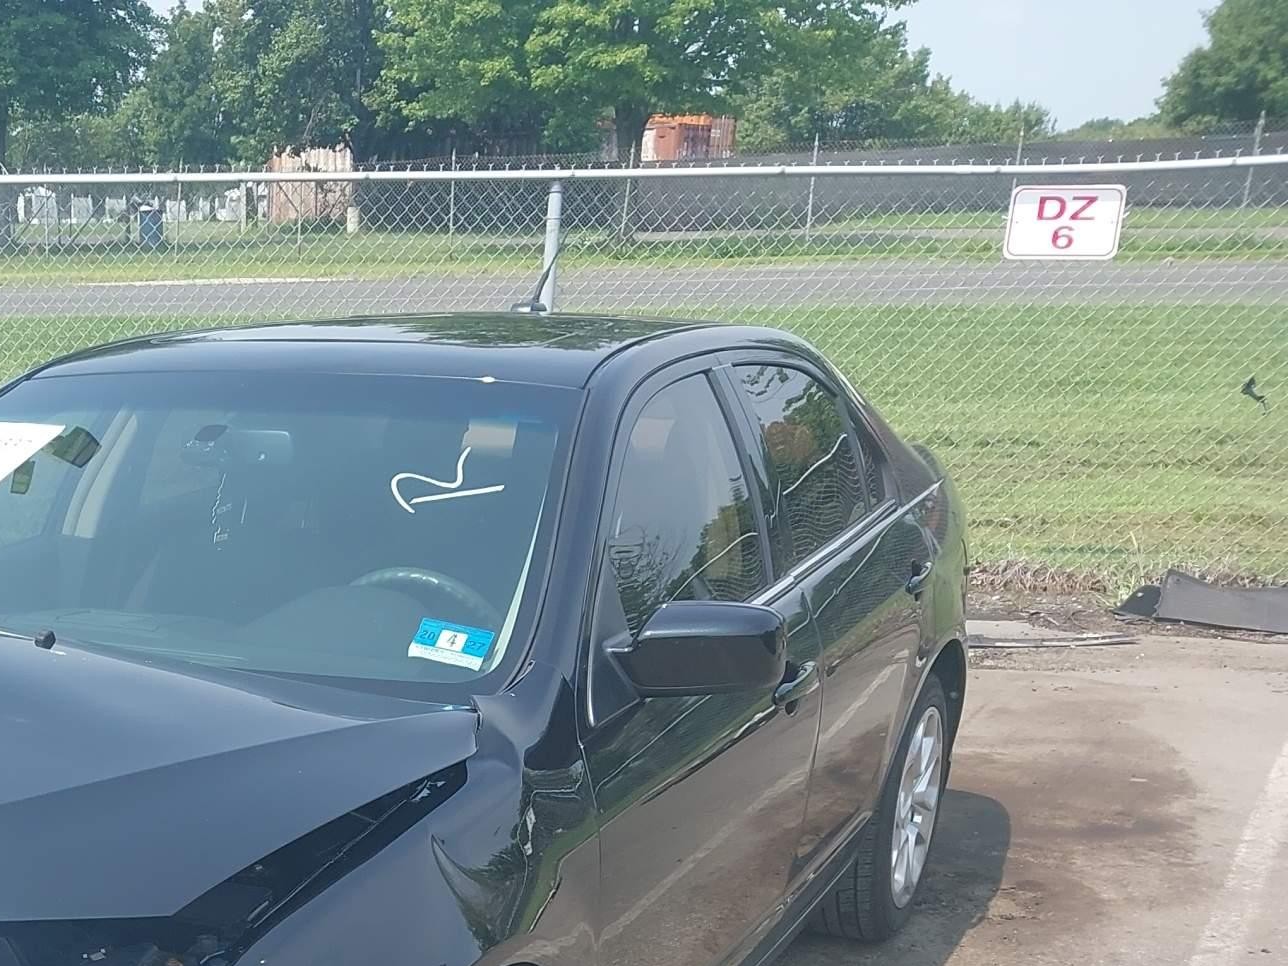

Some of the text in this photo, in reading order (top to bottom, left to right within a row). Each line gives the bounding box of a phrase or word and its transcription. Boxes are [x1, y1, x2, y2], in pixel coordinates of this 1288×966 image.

[1036, 195, 1100, 221] DZ
[1051, 225, 1076, 250] 6
[419, 630, 436, 640] 20
[446, 632, 458, 648] 4
